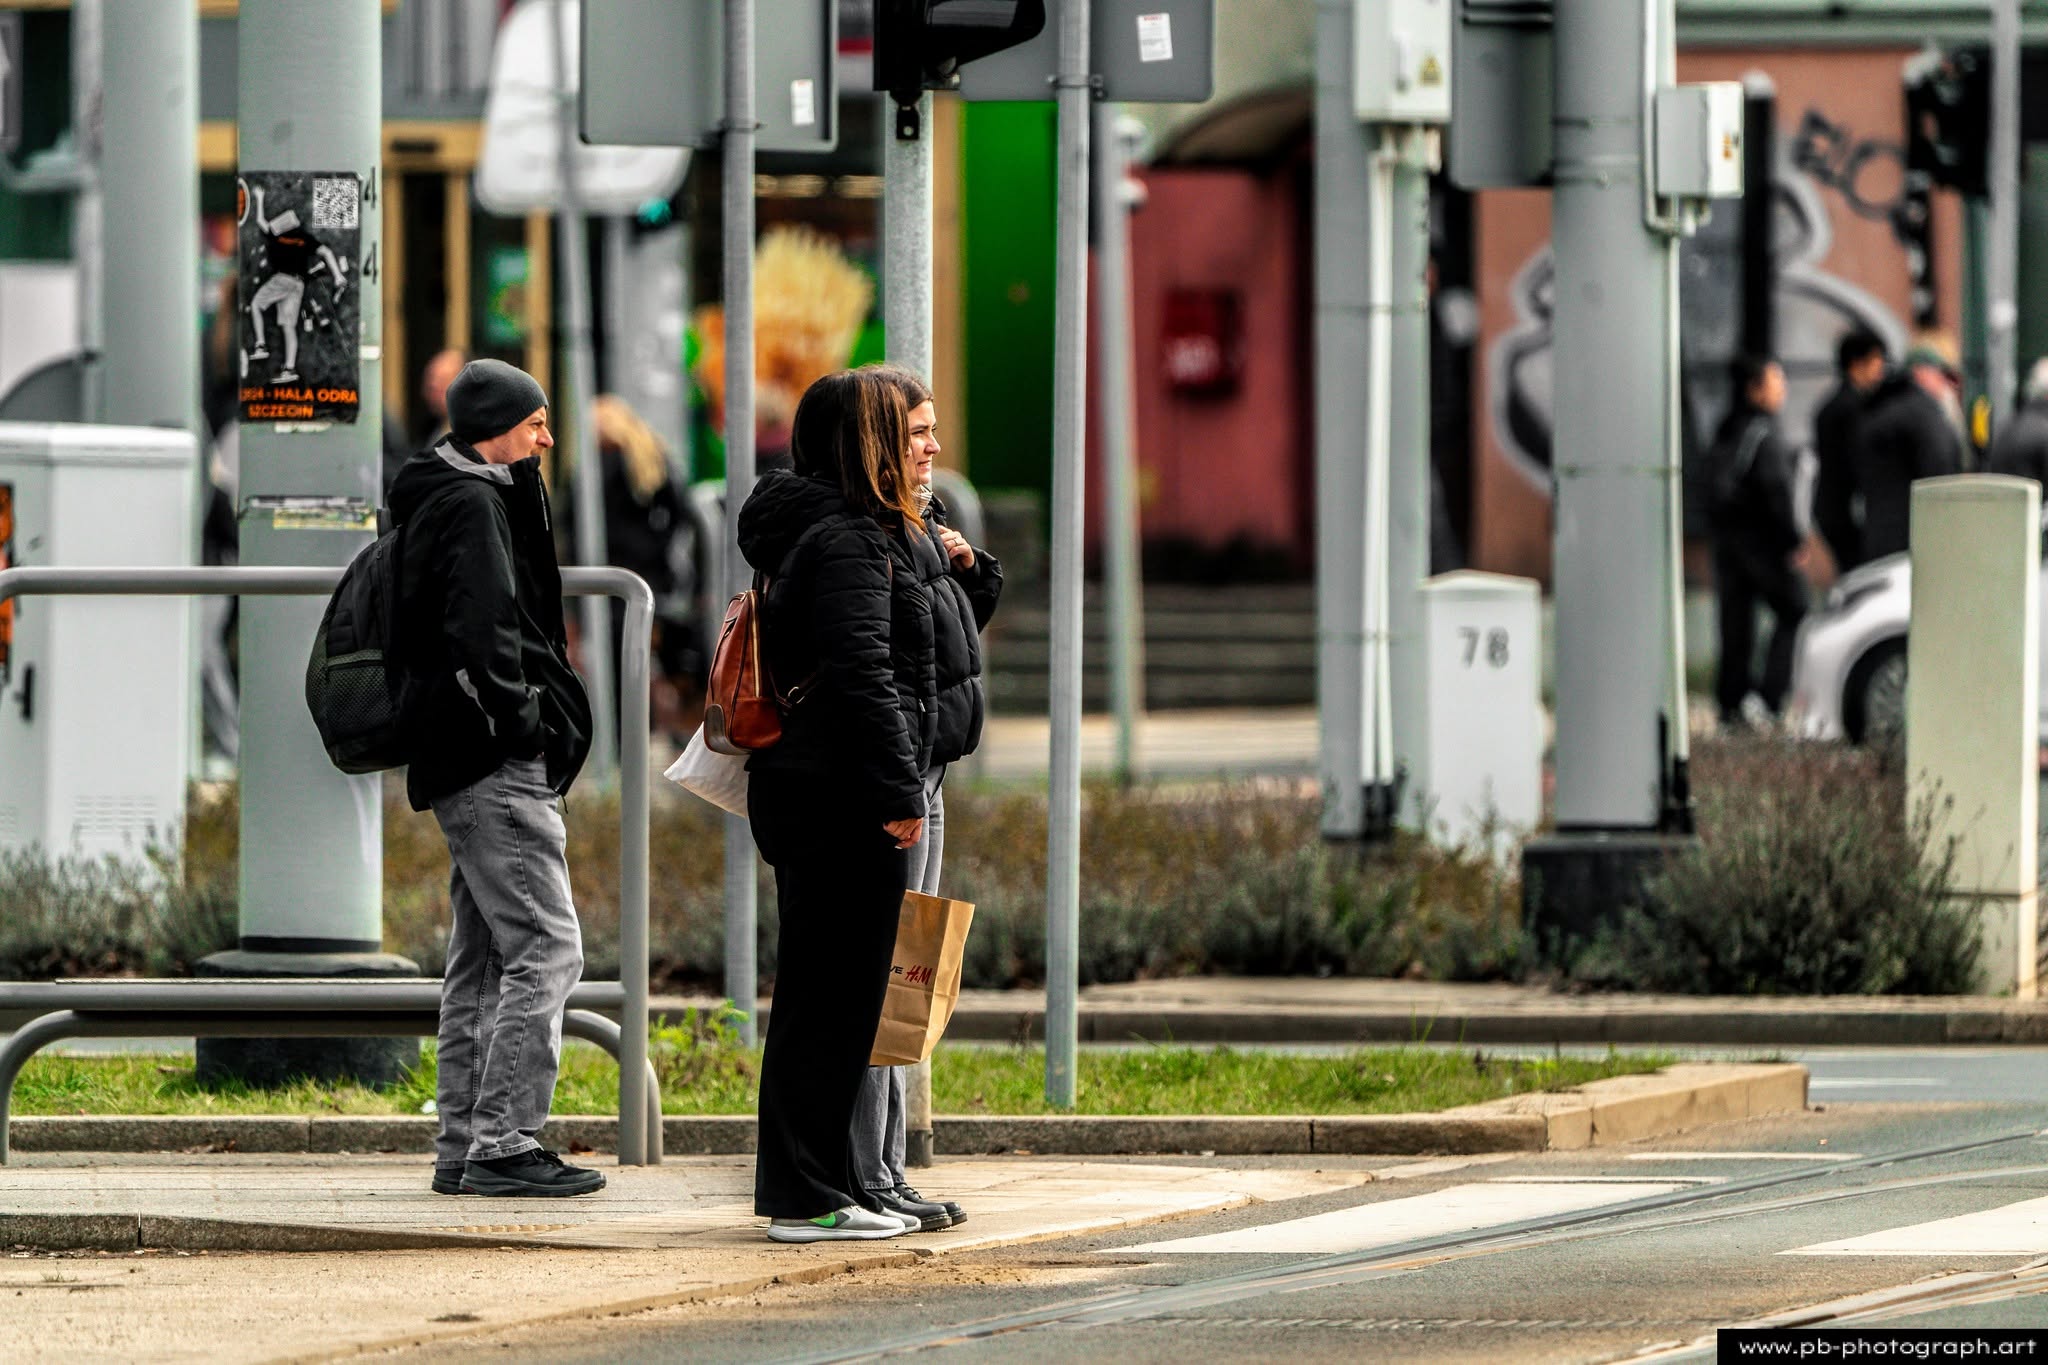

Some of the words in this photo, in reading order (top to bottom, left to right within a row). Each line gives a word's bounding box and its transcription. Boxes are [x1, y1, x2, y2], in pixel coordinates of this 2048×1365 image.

[273, 388, 314, 401] HALA
[317, 388, 358, 403] ODRA
[1458, 626, 1509, 669] 78
